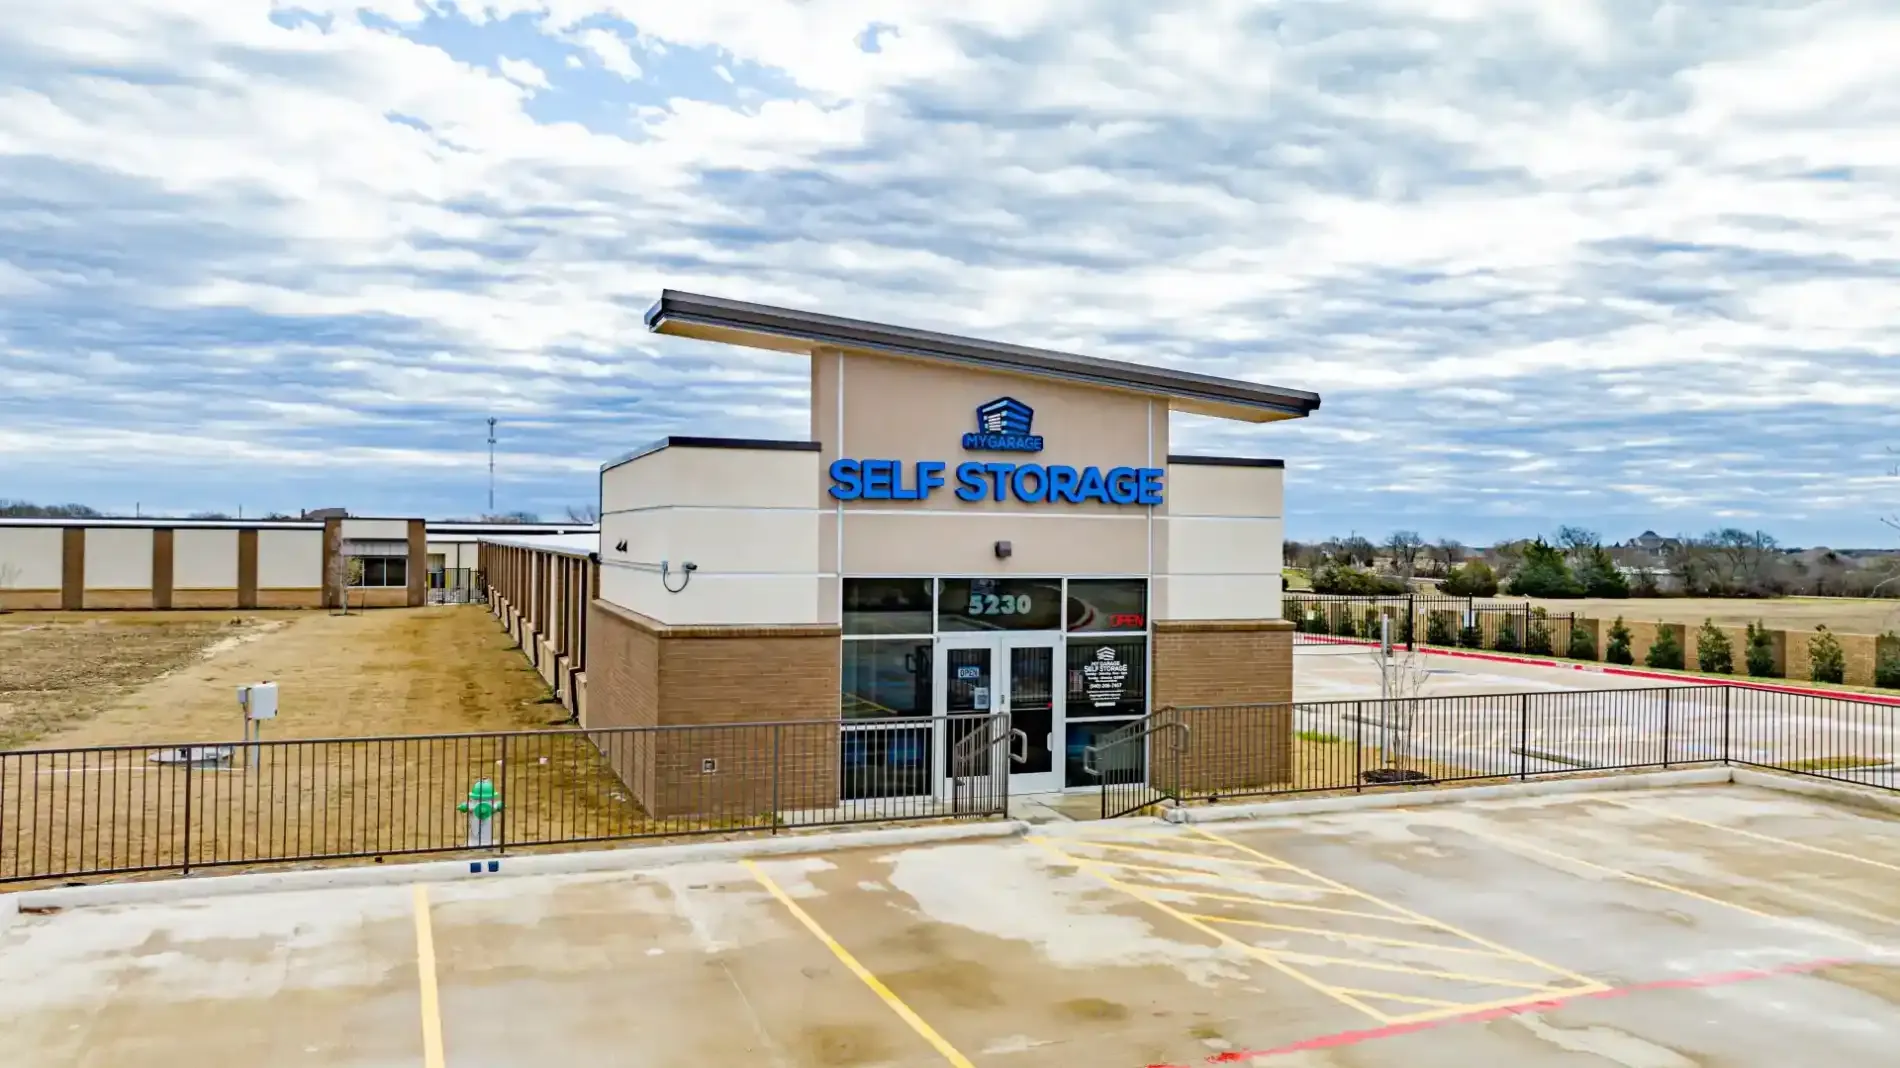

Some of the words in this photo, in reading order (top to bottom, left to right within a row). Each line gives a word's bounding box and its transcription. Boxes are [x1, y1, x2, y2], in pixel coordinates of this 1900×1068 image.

[828, 458, 945, 500] SELF
[955, 461, 1164, 505] STORAGE
[968, 594, 1032, 615] 5230
[1109, 613, 1144, 628] OPEN
[959, 668, 979, 678] OPEN
